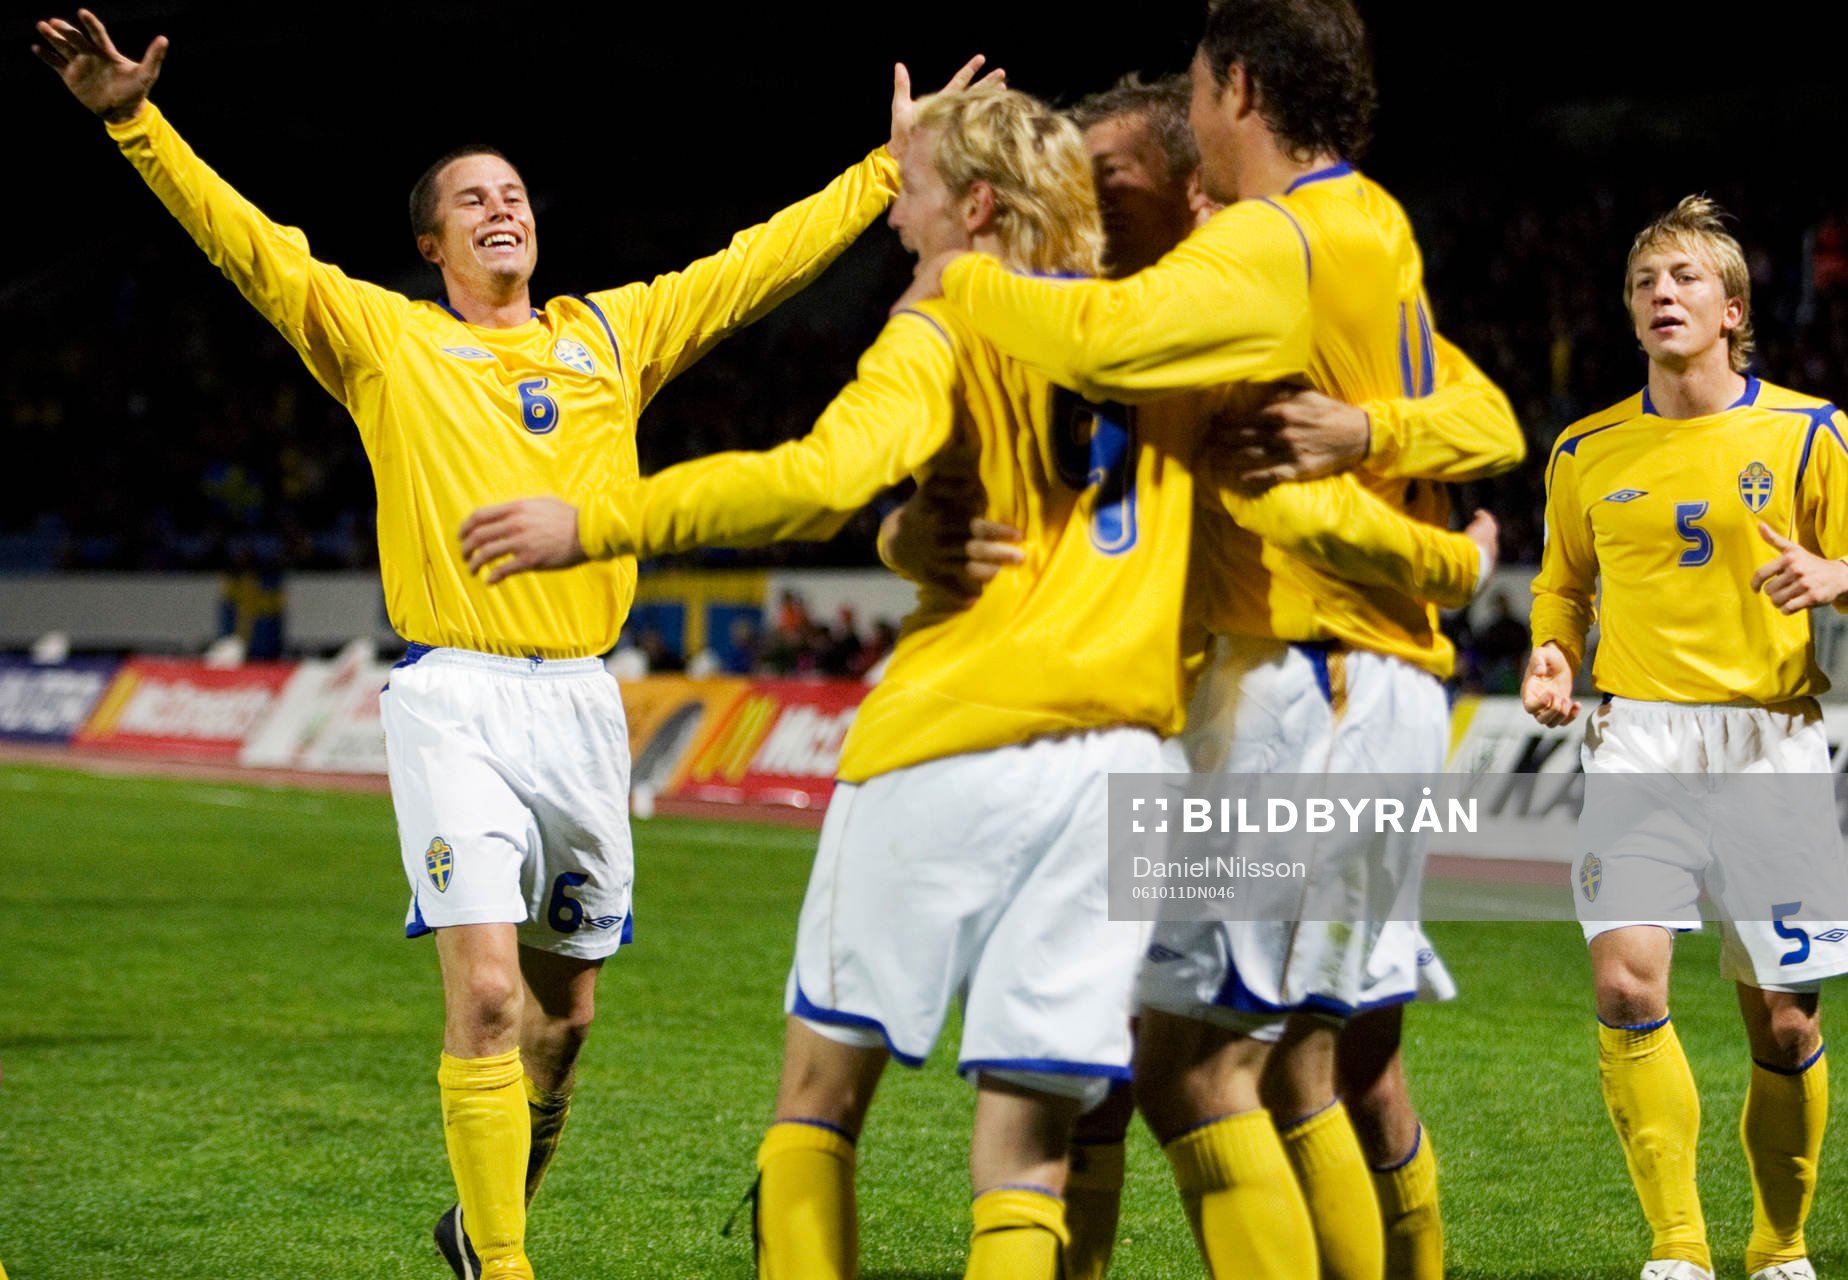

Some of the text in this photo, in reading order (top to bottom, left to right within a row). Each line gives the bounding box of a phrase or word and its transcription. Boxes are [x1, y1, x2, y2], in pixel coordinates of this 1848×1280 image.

[517, 377, 559, 435] 6
[1674, 501, 1714, 567] 5
[547, 871, 589, 934] 6
[1771, 901, 1810, 966] 5
